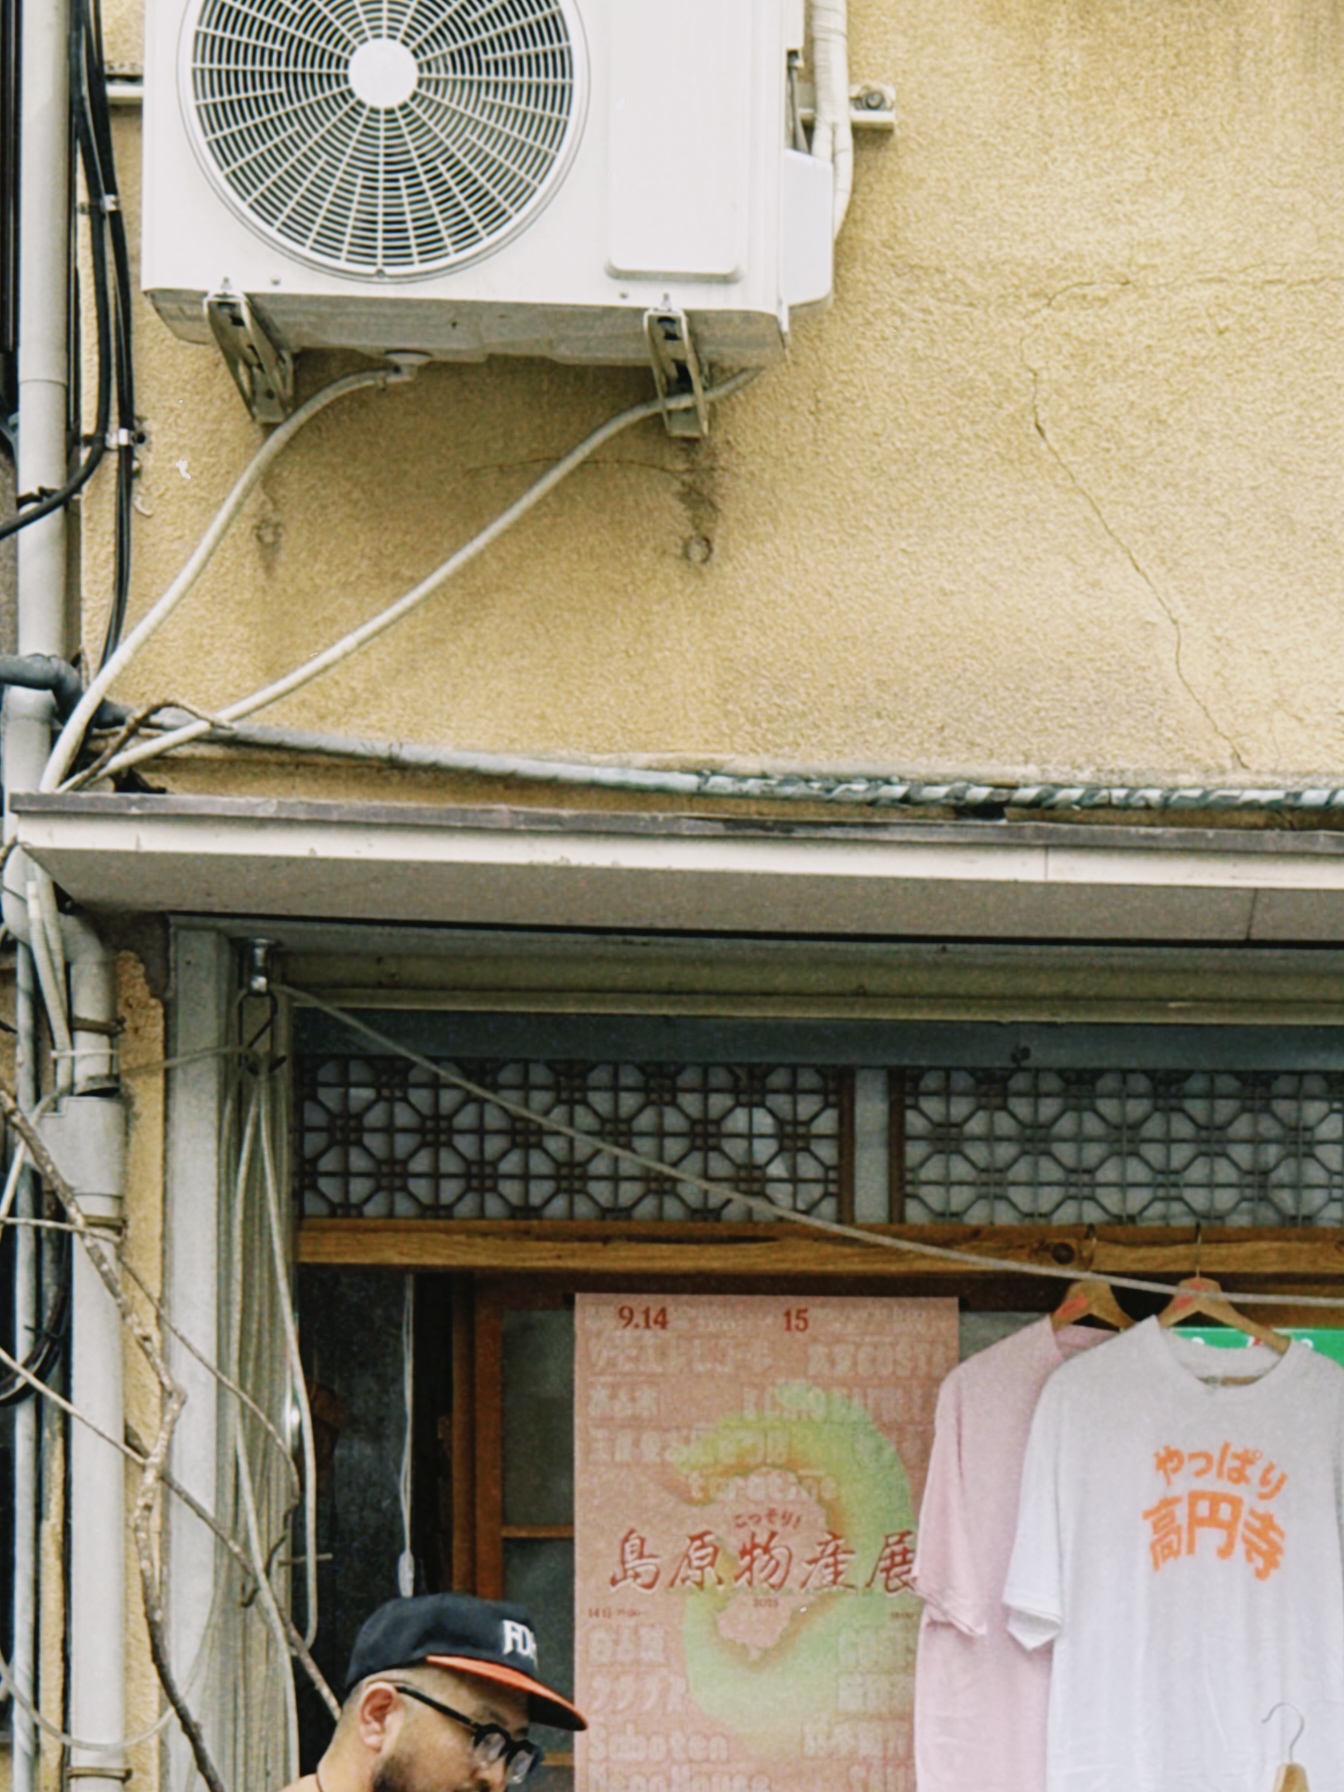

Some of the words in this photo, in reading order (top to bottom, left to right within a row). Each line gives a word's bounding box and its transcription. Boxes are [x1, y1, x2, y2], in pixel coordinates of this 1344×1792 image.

[617, 1306, 669, 1330] 9.14
[783, 1308, 809, 1332] 15
[1154, 1441, 1287, 1500] やっぱり
[609, 1526, 918, 1594] 島原物産展
[1142, 1489, 1285, 1580] 高円寺
